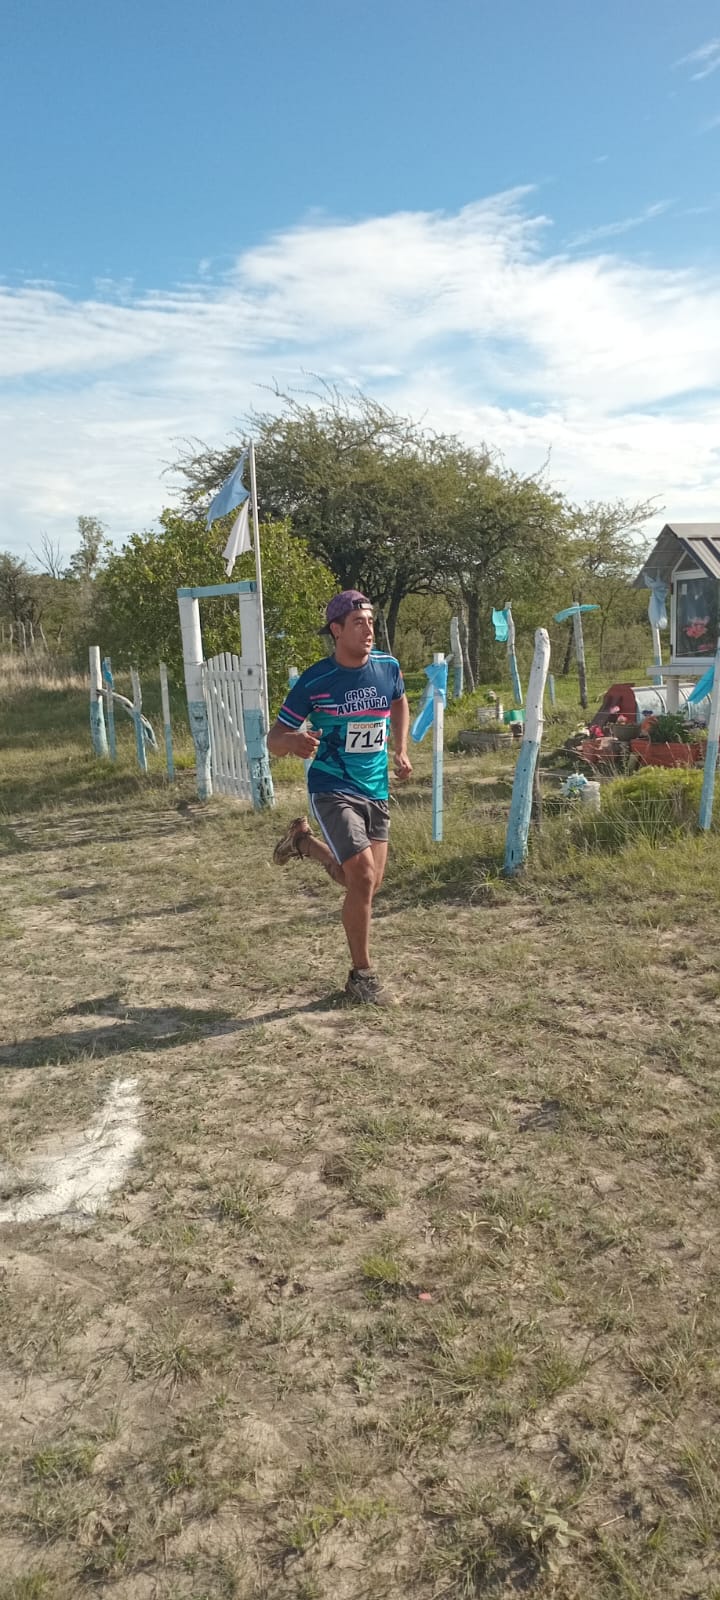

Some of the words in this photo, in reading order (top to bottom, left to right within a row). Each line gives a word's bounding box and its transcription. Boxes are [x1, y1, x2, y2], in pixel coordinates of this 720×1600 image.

[345, 687, 377, 702] CROSS
[337, 696, 387, 715] AVENTURA
[349, 729, 384, 748] 714
